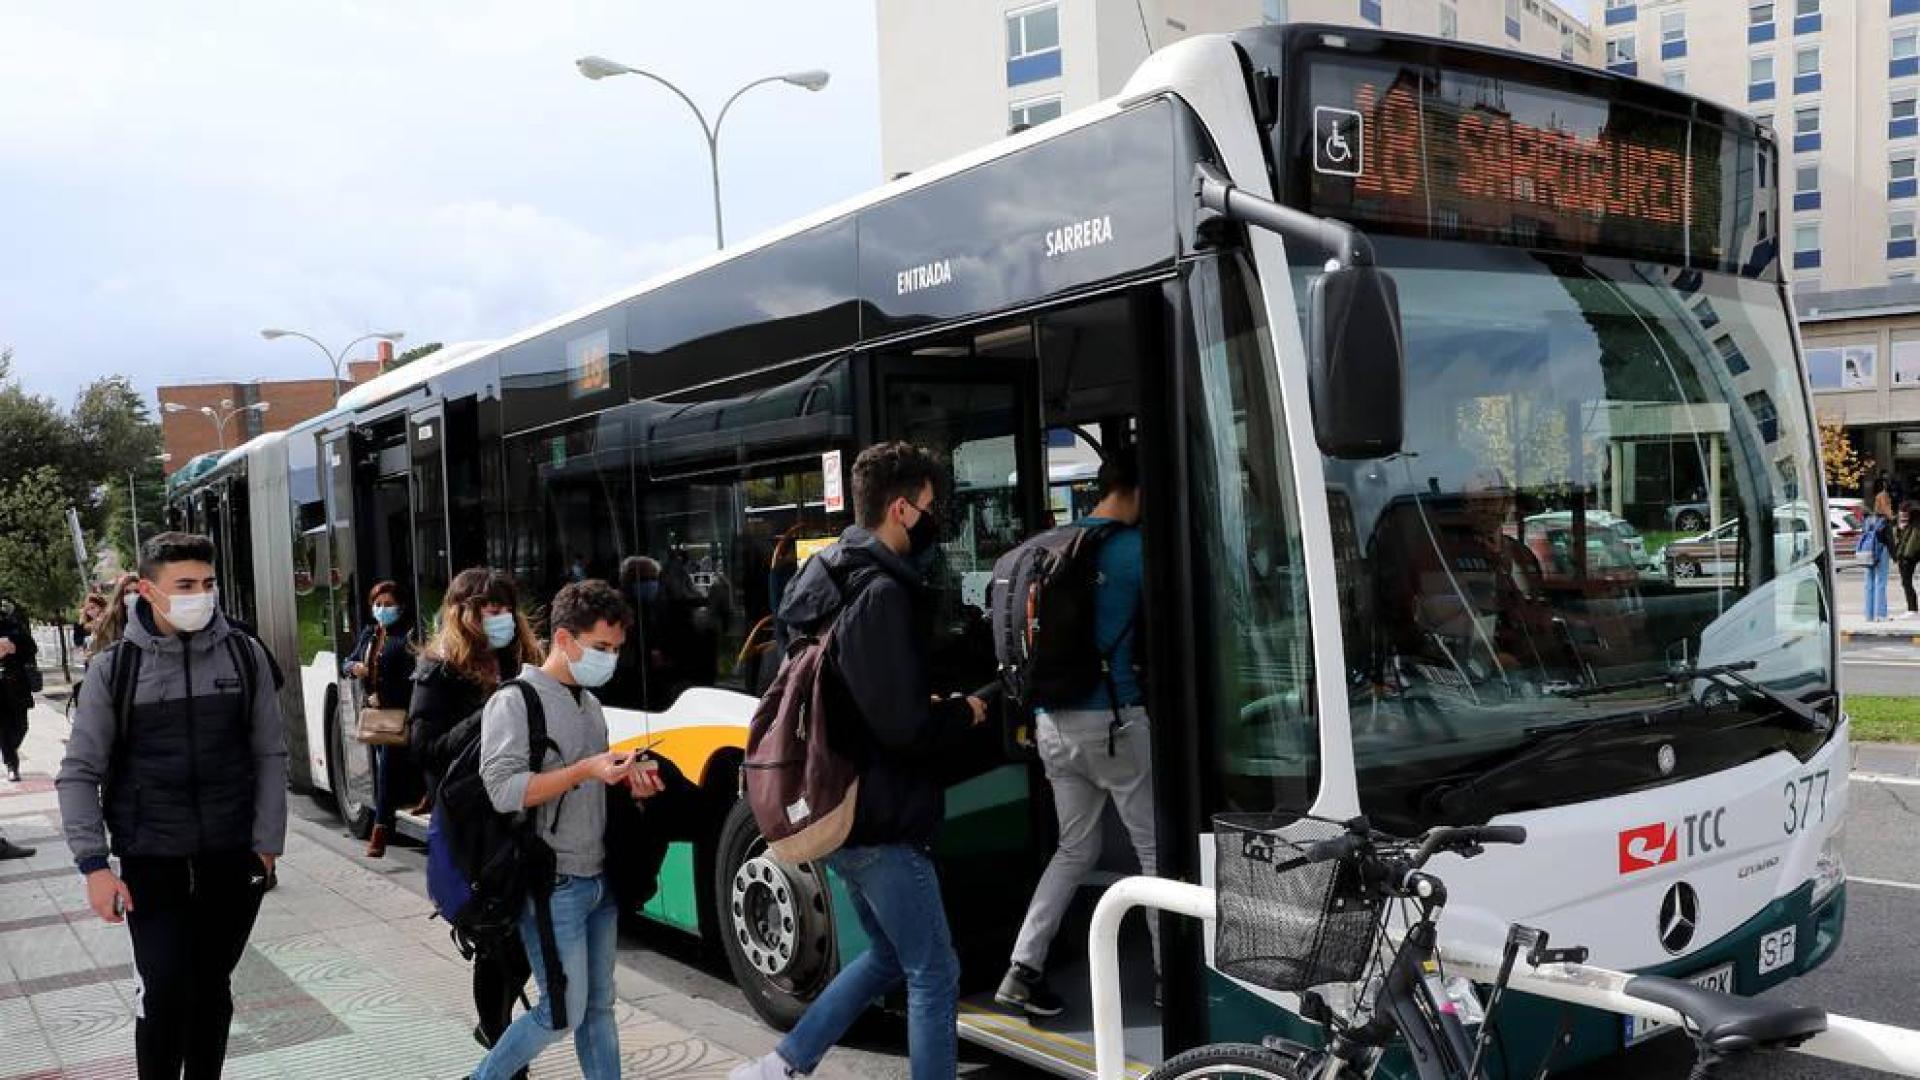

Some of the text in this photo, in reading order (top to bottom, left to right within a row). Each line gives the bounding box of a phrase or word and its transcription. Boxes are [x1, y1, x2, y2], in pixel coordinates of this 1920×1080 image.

[1046, 215, 1112, 256] SARRERA
[897, 258, 951, 295] ENTRADA
[1783, 769, 1830, 834] 377
[1683, 806, 1726, 857] TCC
[1764, 931, 1793, 966] SP
